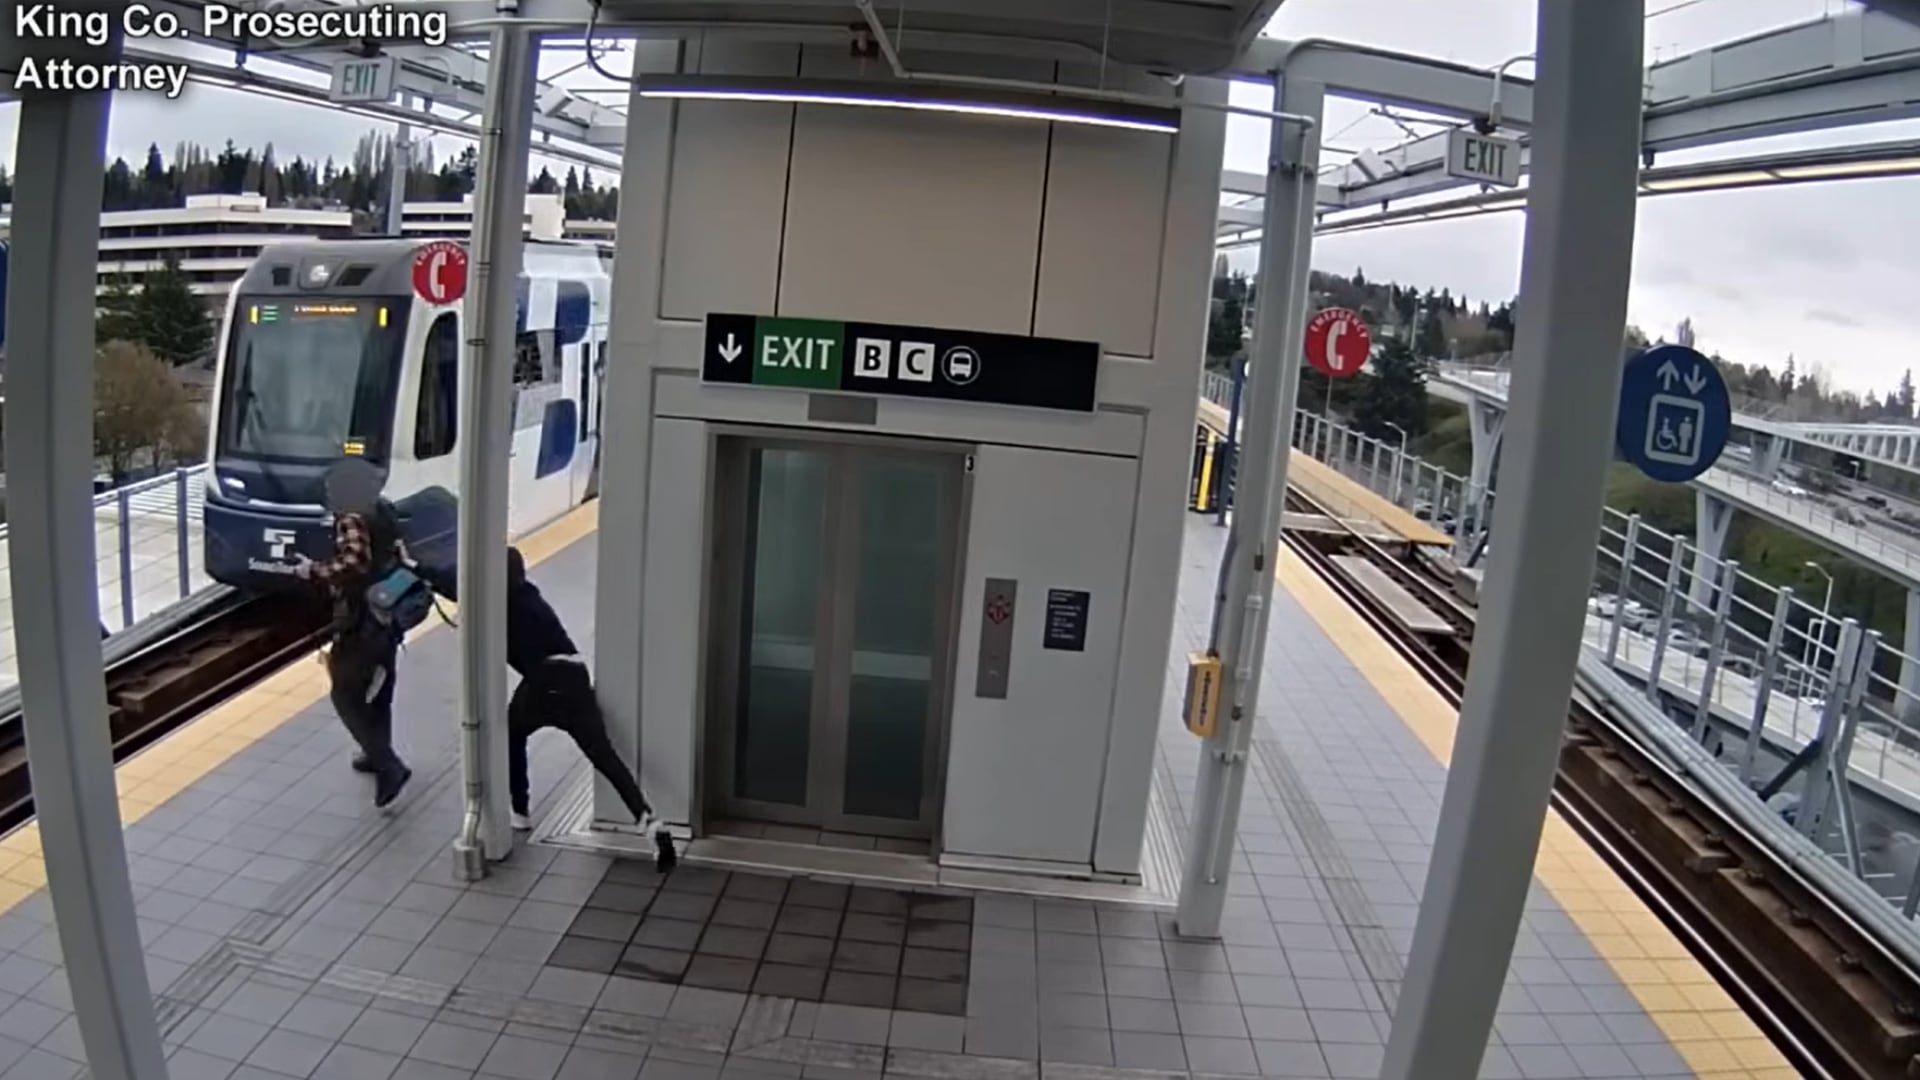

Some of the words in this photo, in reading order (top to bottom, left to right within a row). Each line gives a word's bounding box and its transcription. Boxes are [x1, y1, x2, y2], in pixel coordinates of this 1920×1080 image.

[341, 64, 381, 97] EXIT
[1464, 137, 1508, 179] EXIT
[1309, 310, 1369, 338] EMERGENCY
[761, 334, 836, 370] EXIT
[863, 345, 881, 371] B
[906, 348, 926, 374] C
